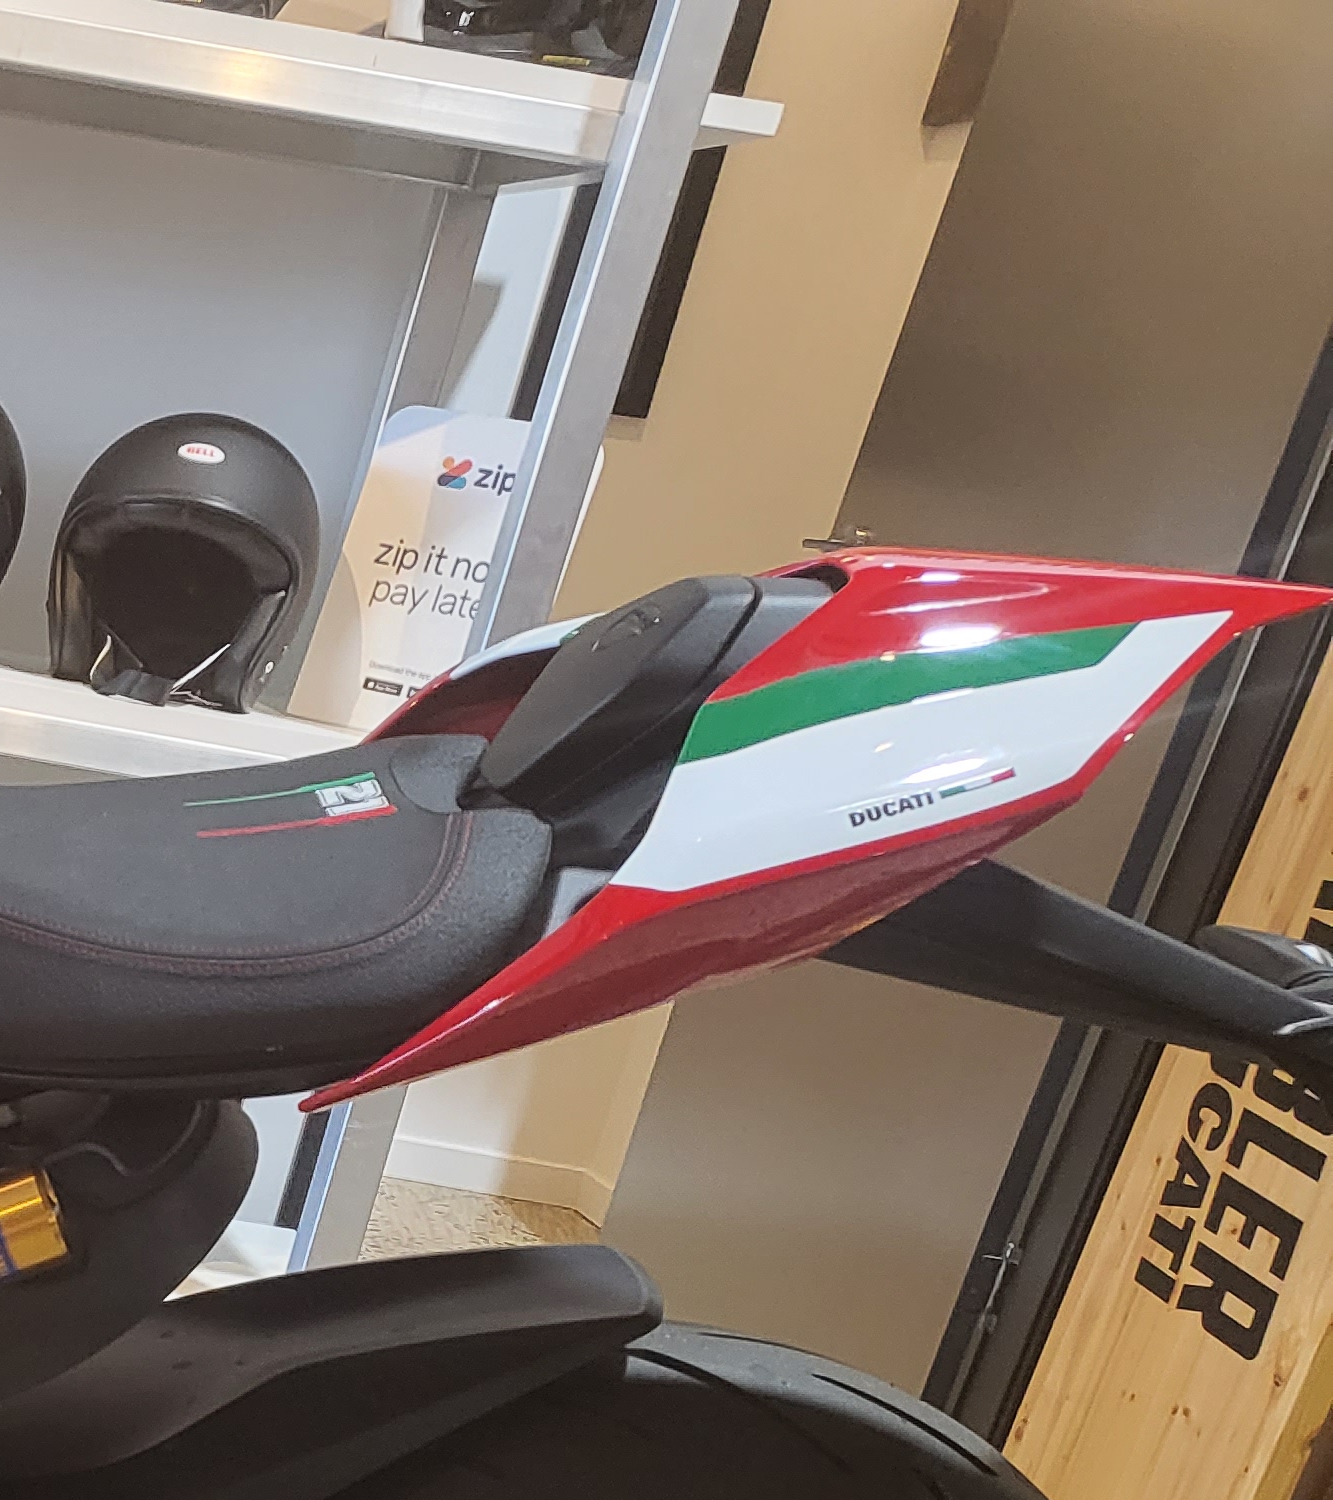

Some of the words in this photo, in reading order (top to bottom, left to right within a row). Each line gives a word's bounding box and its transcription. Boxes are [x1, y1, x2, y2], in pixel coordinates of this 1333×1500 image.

[473, 464, 516, 496] zip
[373, 539, 419, 575] zip
[423, 545, 448, 576] it
[450, 556, 491, 584] no
[368, 579, 430, 615] pay
[431, 583, 483, 620] late
[848, 790, 935, 828] DUCATI
[1135, 1055, 1245, 1304] CATI
